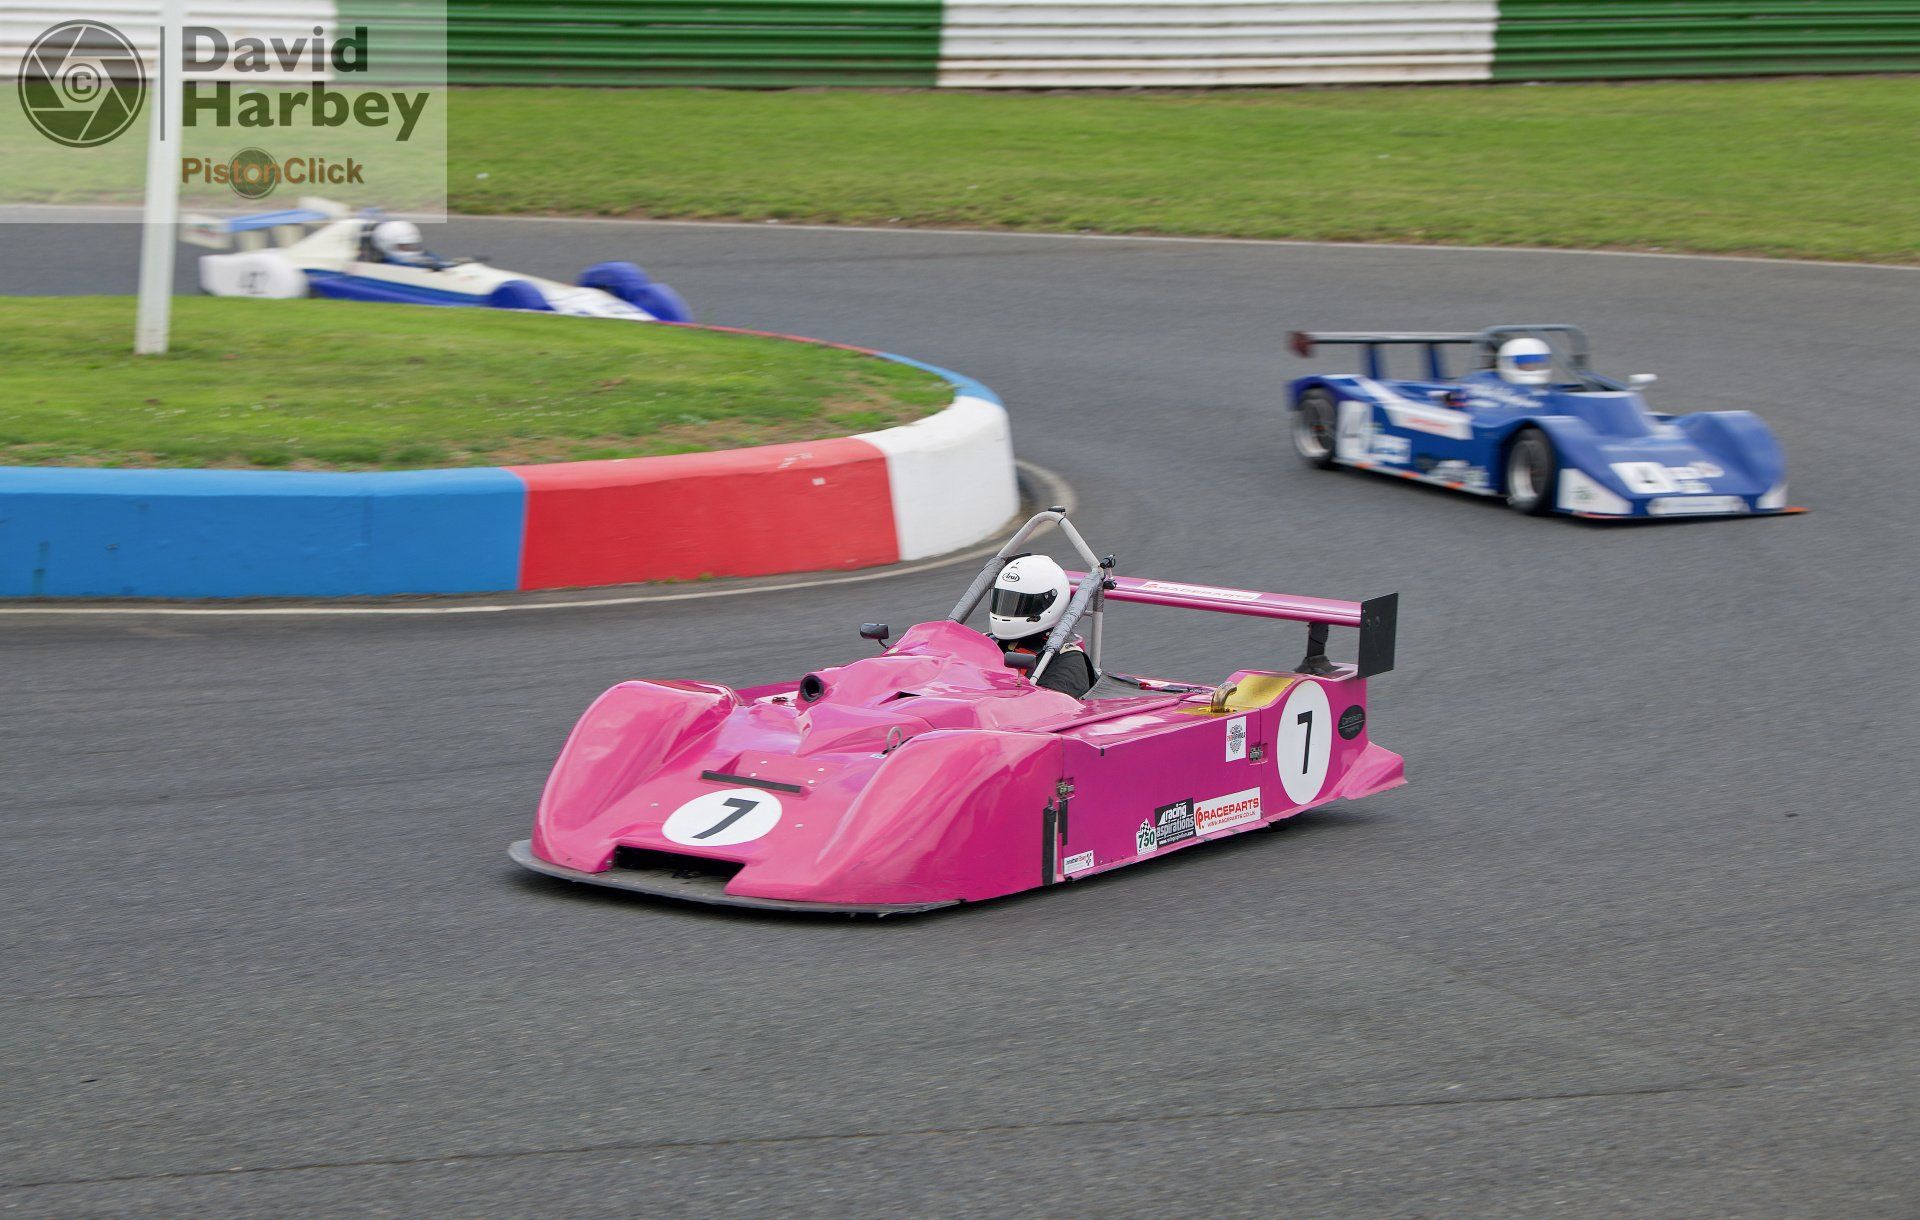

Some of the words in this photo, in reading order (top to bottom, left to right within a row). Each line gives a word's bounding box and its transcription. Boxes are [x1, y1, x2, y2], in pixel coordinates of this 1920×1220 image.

[1297, 710, 1313, 775] 7
[690, 797, 760, 840] 7
[1165, 802, 1187, 822] racing
[1203, 797, 1259, 821] RACEPARTS
[1156, 817, 1194, 839] aspirations
[1138, 831, 1155, 849] 750
